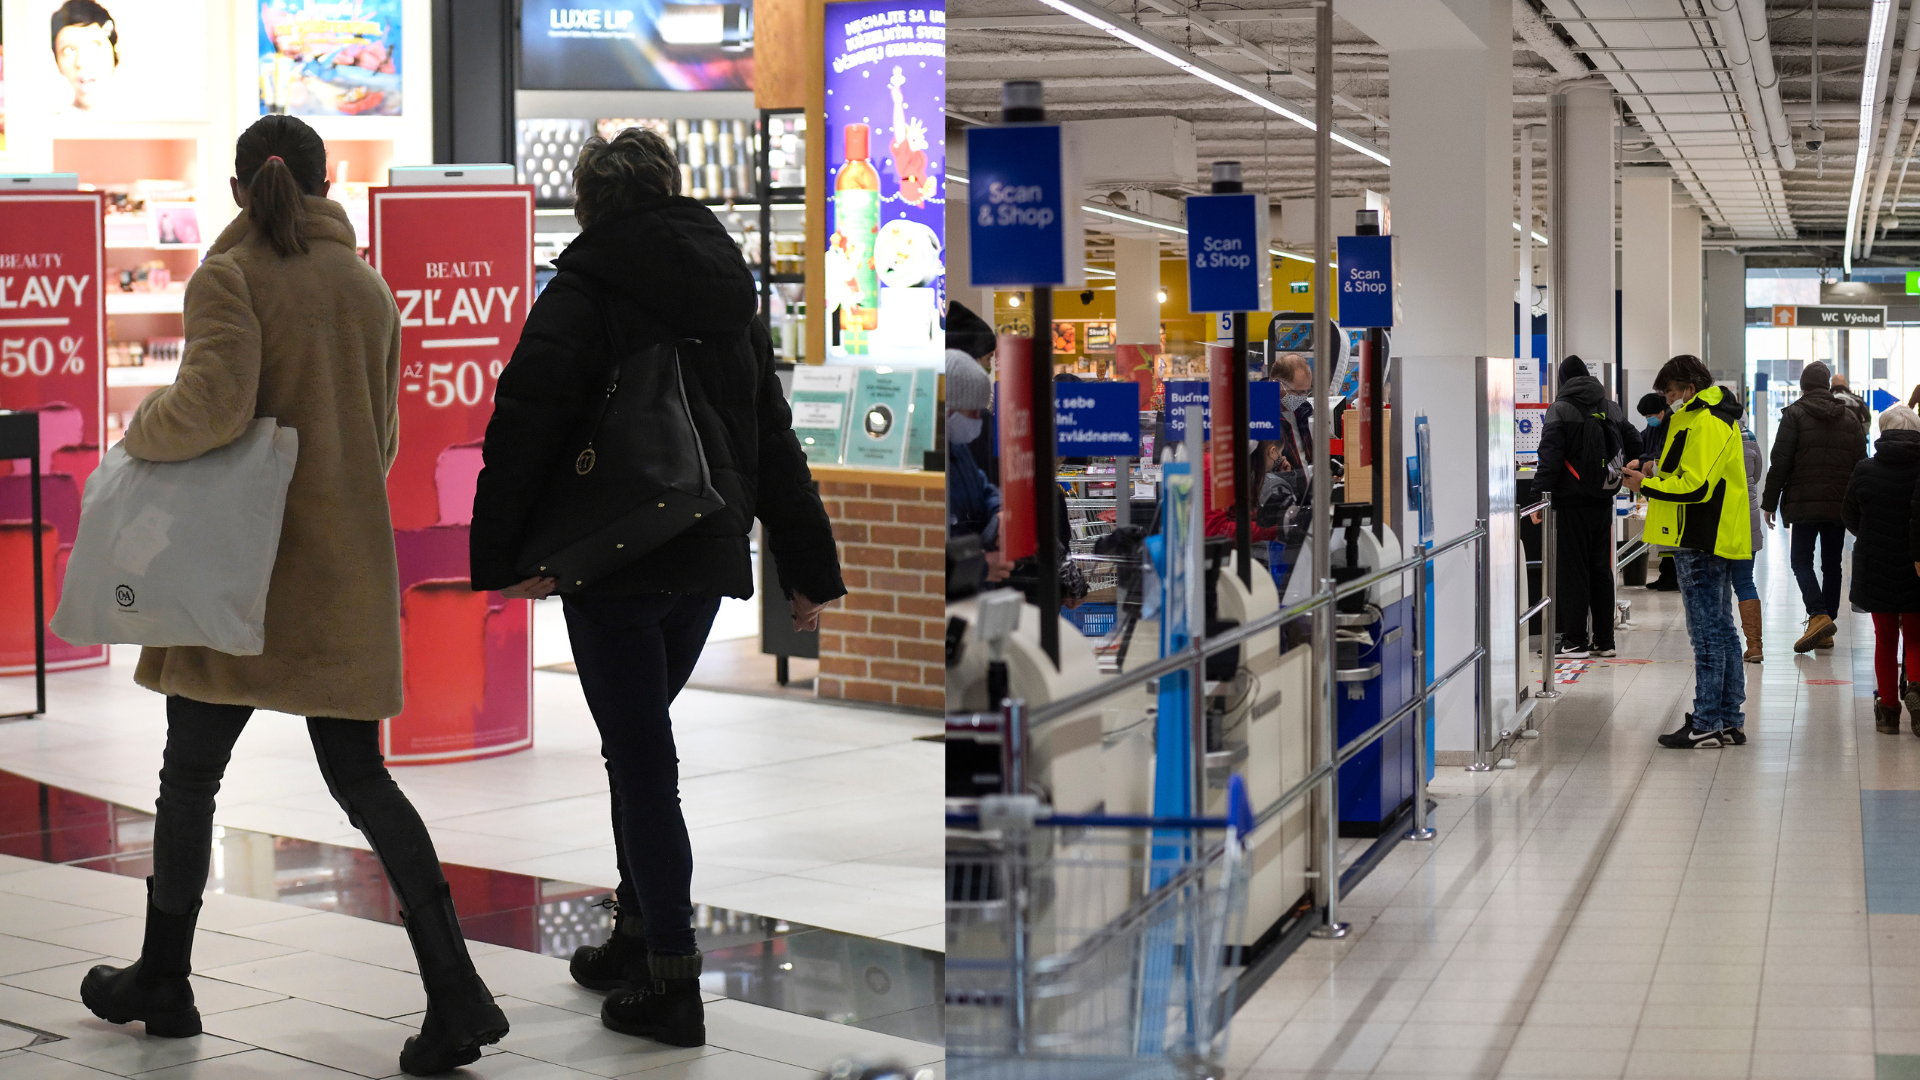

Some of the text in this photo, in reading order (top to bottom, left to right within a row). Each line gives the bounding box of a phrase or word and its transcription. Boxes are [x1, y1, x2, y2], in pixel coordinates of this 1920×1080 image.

[550, 8, 634, 30] LUXE LIP
[908, 9, 926, 22] SA
[989, 182, 1042, 204] Scan
[978, 205, 1054, 229] & Shop
[1203, 236, 1242, 252] Scan
[1195, 252, 1251, 269] & Shop
[426, 261, 493, 278] BEAUTY
[1350, 268, 1380, 279] Scan
[1344, 281, 1387, 294] & Shop
[396, 286, 519, 327] ZĽAVY
[1222, 312, 1232, 330] 5
[1821, 312, 1880, 324] WC Východ
[403, 361, 423, 378] AŽ
[1062, 396, 1095, 409] sebe
[1171, 392, 1209, 403] Buďme
[1058, 429, 1132, 442] zvládneme.
